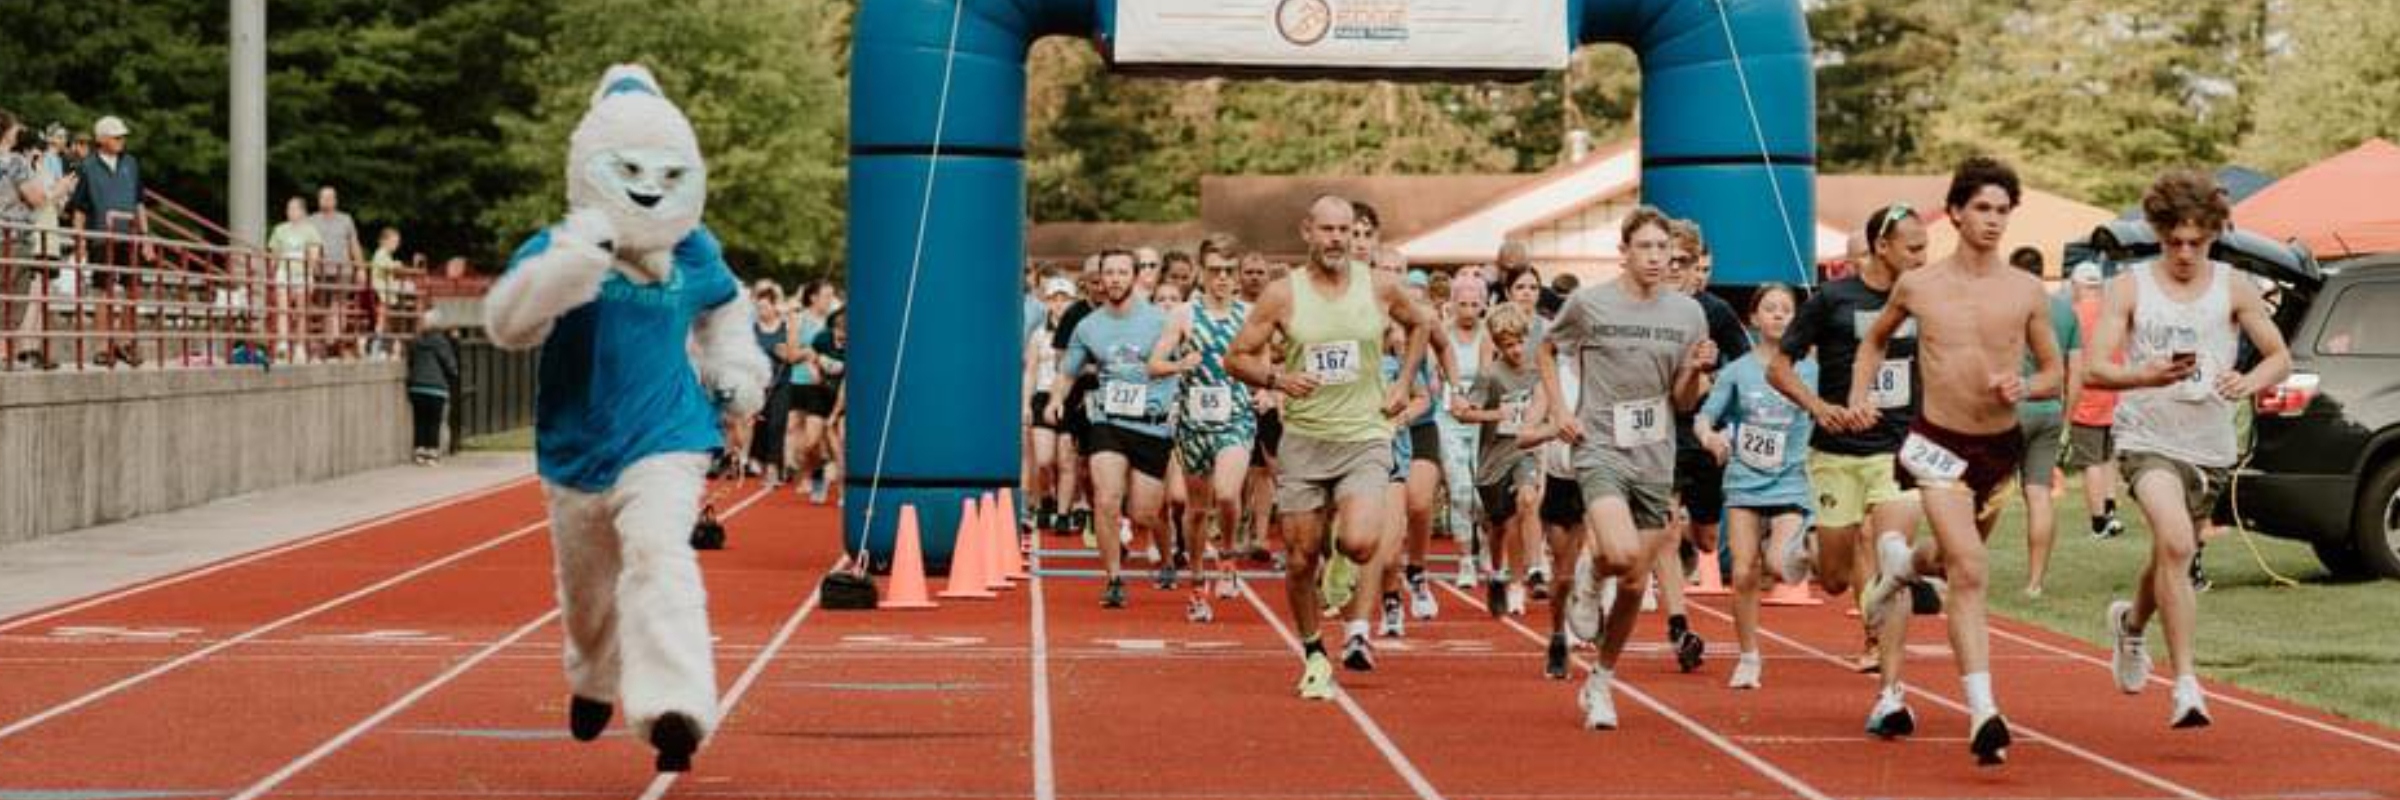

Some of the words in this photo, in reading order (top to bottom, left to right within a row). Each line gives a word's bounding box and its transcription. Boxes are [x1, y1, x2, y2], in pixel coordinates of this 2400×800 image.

[1593, 324, 1651, 340] MICHIGAN
[1316, 350, 1348, 370] 167
[1112, 387, 1139, 405] 237
[1201, 393, 1220, 409] 65
[1631, 407, 1653, 429] 30
[1744, 433, 1775, 455] 226
[1910, 446, 1956, 473] 248
